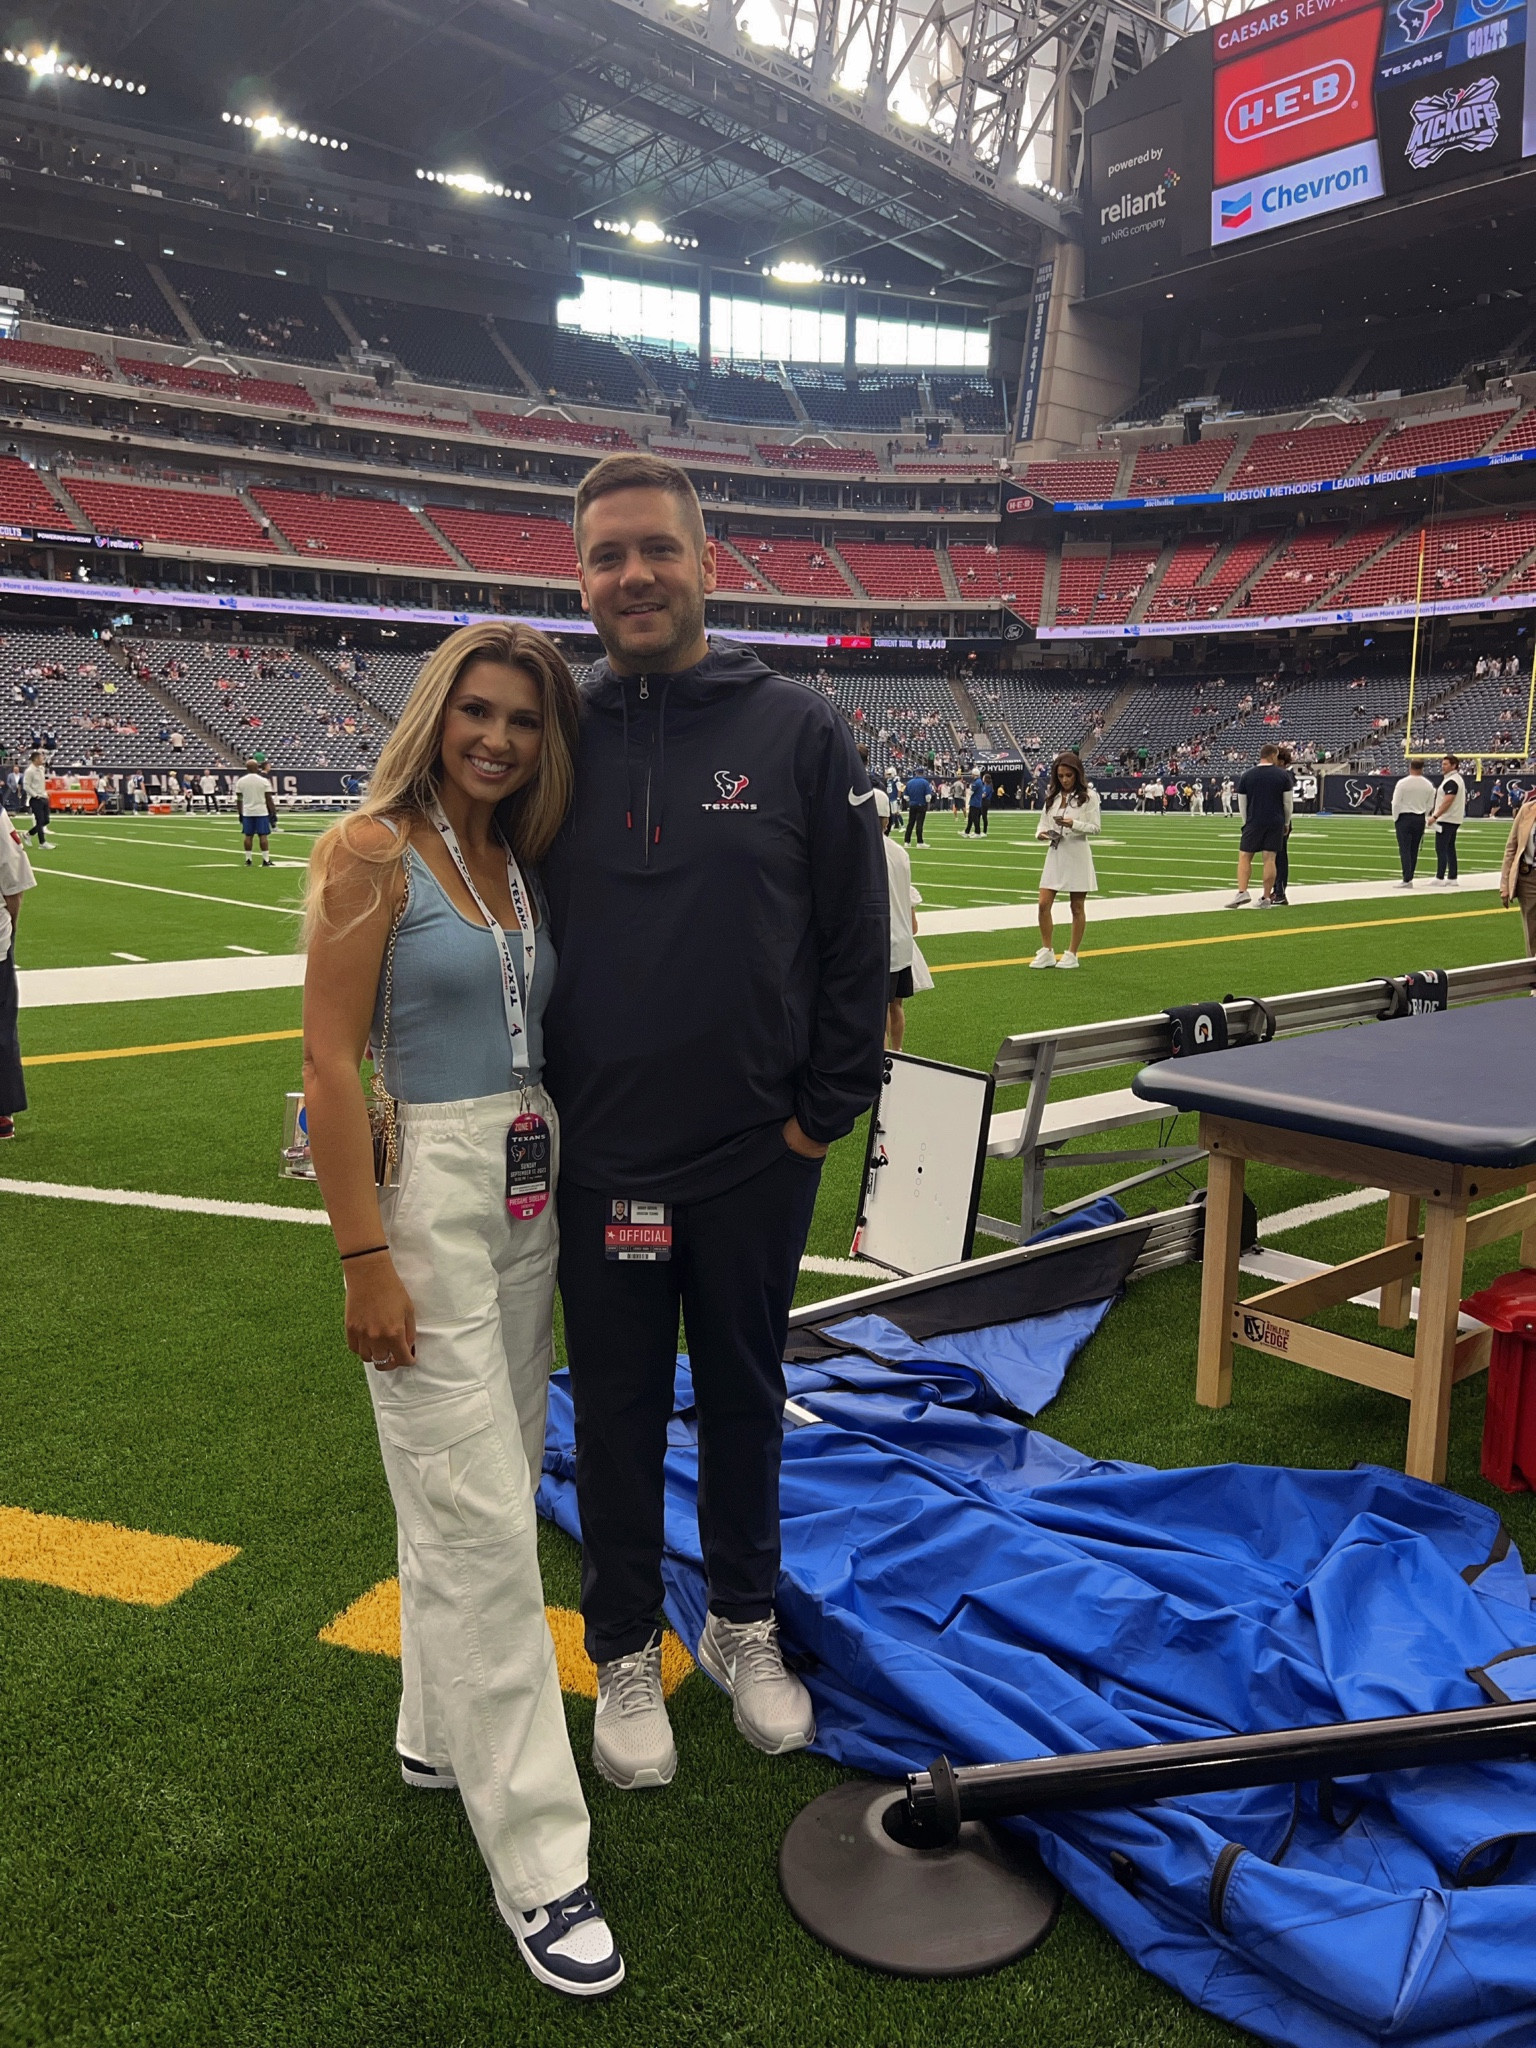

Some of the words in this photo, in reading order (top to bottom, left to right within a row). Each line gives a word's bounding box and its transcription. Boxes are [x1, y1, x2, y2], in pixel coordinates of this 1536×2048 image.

[1218, 9, 1289, 49] CAESARS
[1467, 18, 1508, 59] COLTS
[1381, 51, 1443, 78] TEXANS
[1409, 103, 1498, 150] KICKOFF
[1108, 148, 1150, 178] powered
[1150, 145, 1163, 161] by
[1261, 164, 1369, 213] Chevron
[1101, 184, 1166, 226] reliant
[1101, 235, 1110, 245] an
[1111, 227, 1129, 240] NRG
[1130, 217, 1166, 234] company
[1034, 291, 1050, 303] TEXT
[1223, 489, 1267, 502] HOUSTON
[1269, 482, 1323, 497] METHODIST
[1332, 475, 1370, 490] LEADING
[1373, 467, 1417, 484] MEDICINE
[0, 526, 22, 537] COLTS
[3, 582, 21, 590] More
[1404, 602, 1485, 615] HoutonTexans.com/KIDS
[987, 764, 1023, 772] HYUNDAI
[701, 803, 758, 811] TEXANS
[511, 878, 529, 931] TEXANS
[501, 941, 518, 1008] TEXANS
[511, 1134, 546, 1142] TEXANS
[619, 1229, 668, 1243] OFFICIAL
[1264, 1330, 1290, 1350] EDGE
